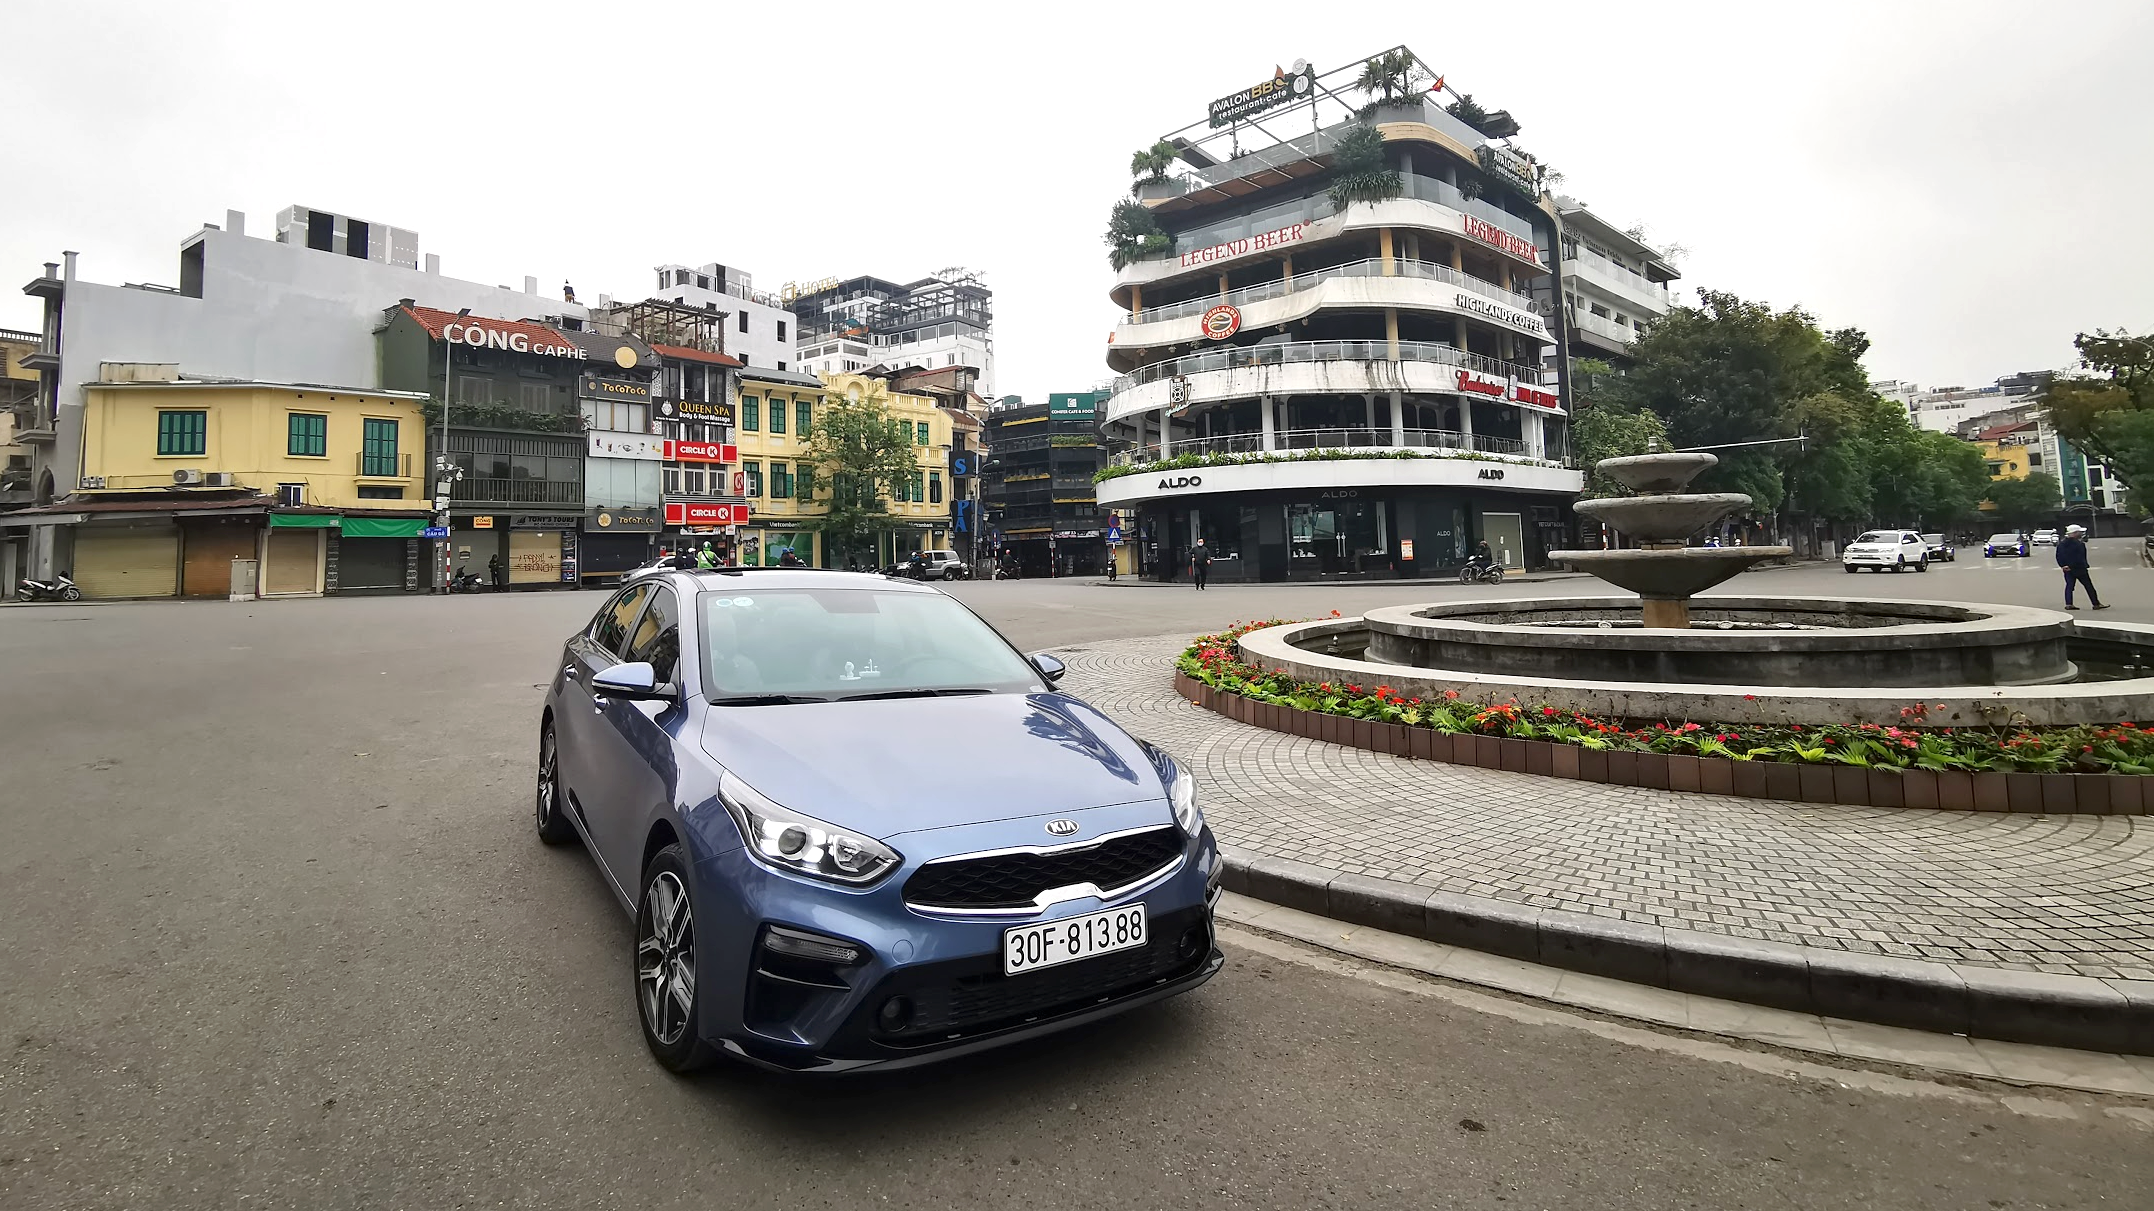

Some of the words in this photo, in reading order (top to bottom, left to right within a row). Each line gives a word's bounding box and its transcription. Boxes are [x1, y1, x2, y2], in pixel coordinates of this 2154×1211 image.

[1212, 91, 1250, 113] AVALON
[1494, 151, 1516, 172] AVALON
[1181, 238, 1248, 267] LEGEND
[1254, 223, 1303, 250] BEER
[1464, 214, 1507, 249] LEGEND
[1509, 235, 1539, 263] BEER
[801, 275, 838, 297] HOTEL
[1203, 307, 1238, 324] HIGHLANDS
[1456, 294, 1512, 322] HIGHLANDS
[1513, 312, 1544, 332] COFFEE
[443, 321, 528, 353] CỘNG
[1208, 327, 1235, 338] COFFEE
[680, 446, 705, 454] CIRCLE
[1158, 476, 1202, 489] ALDO
[1478, 468, 1504, 480] ALDO
[1322, 490, 1358, 498] ALDO
[691, 509, 716, 517] CIRCLE
[1050, 820, 1076, 833] KIA
[1010, 910, 1142, 967] 30F-813.88
